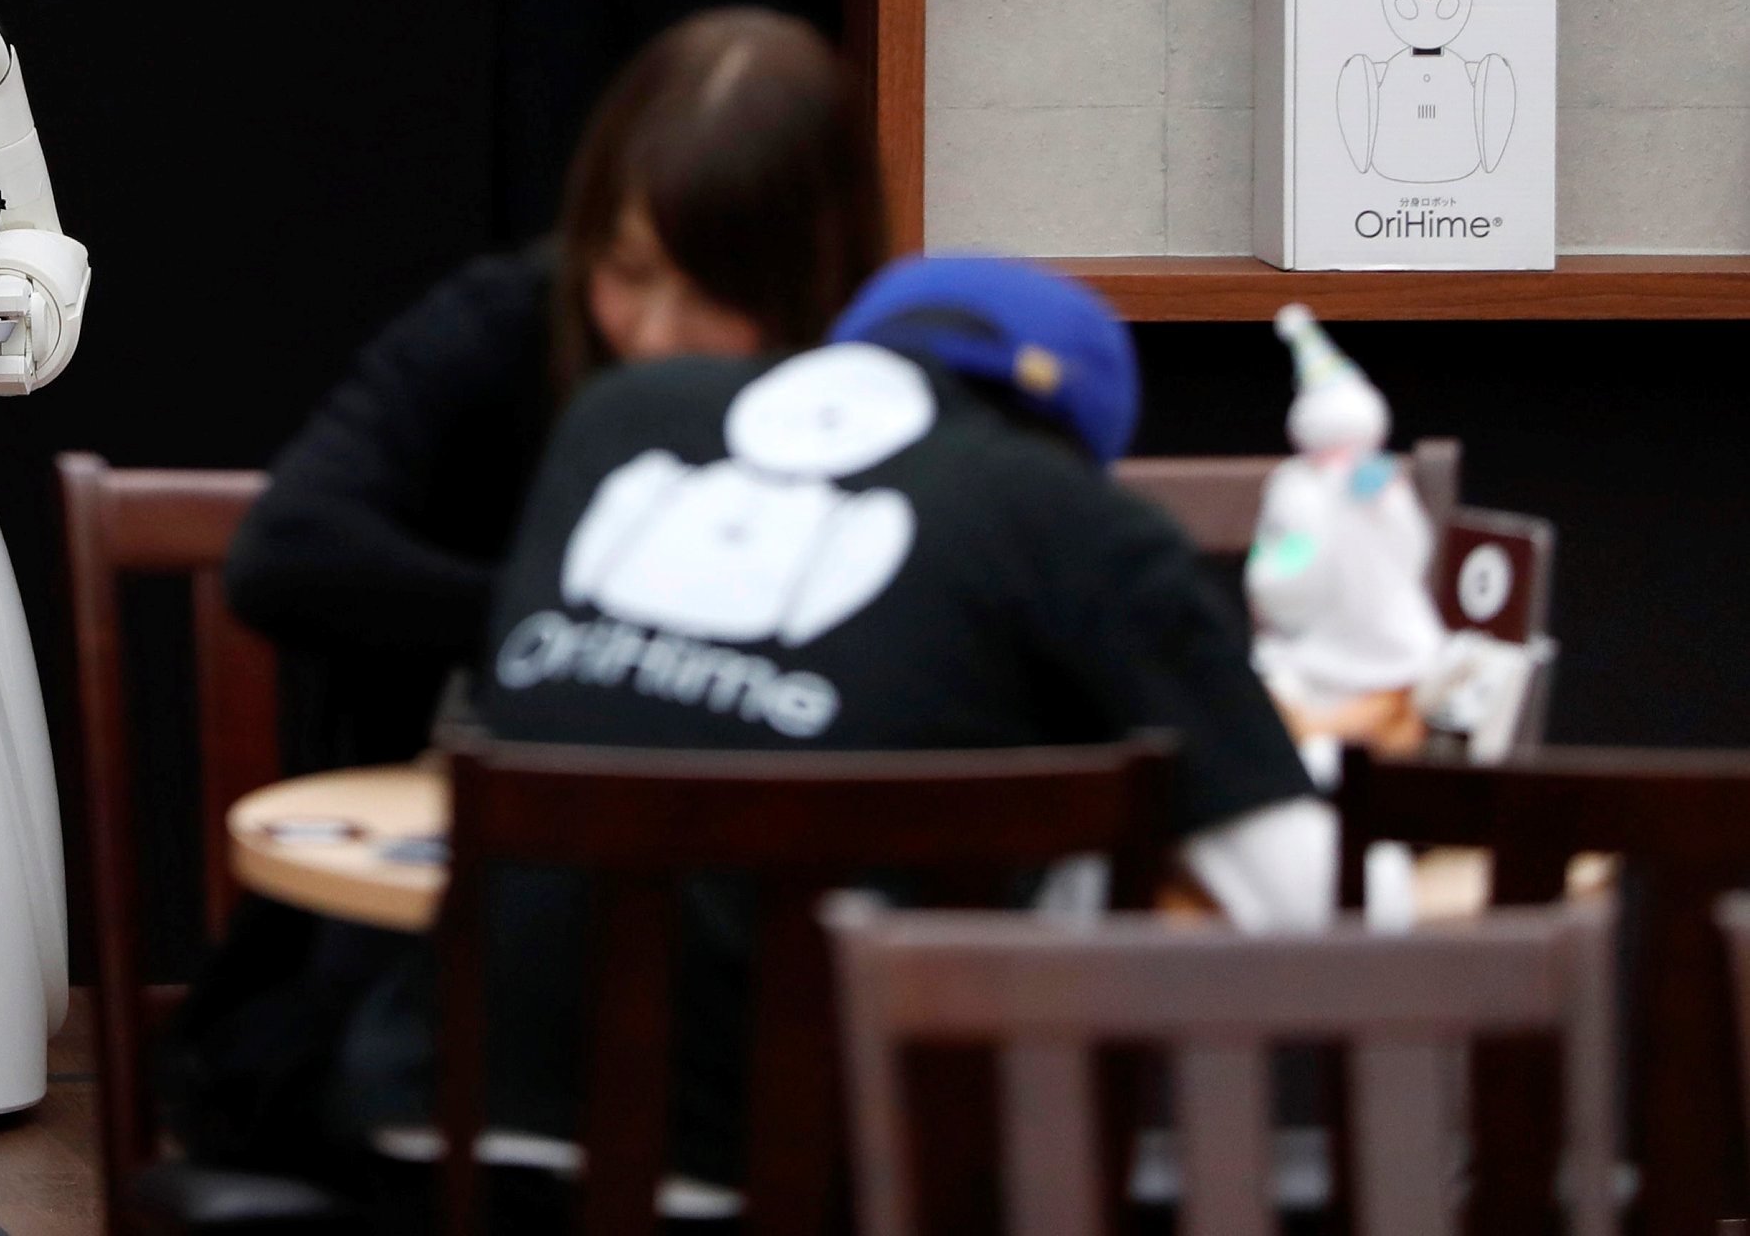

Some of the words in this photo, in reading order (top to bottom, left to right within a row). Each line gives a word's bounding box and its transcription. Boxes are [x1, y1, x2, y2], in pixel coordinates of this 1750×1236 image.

[1399, 197, 1457, 207] 分身ロボット
